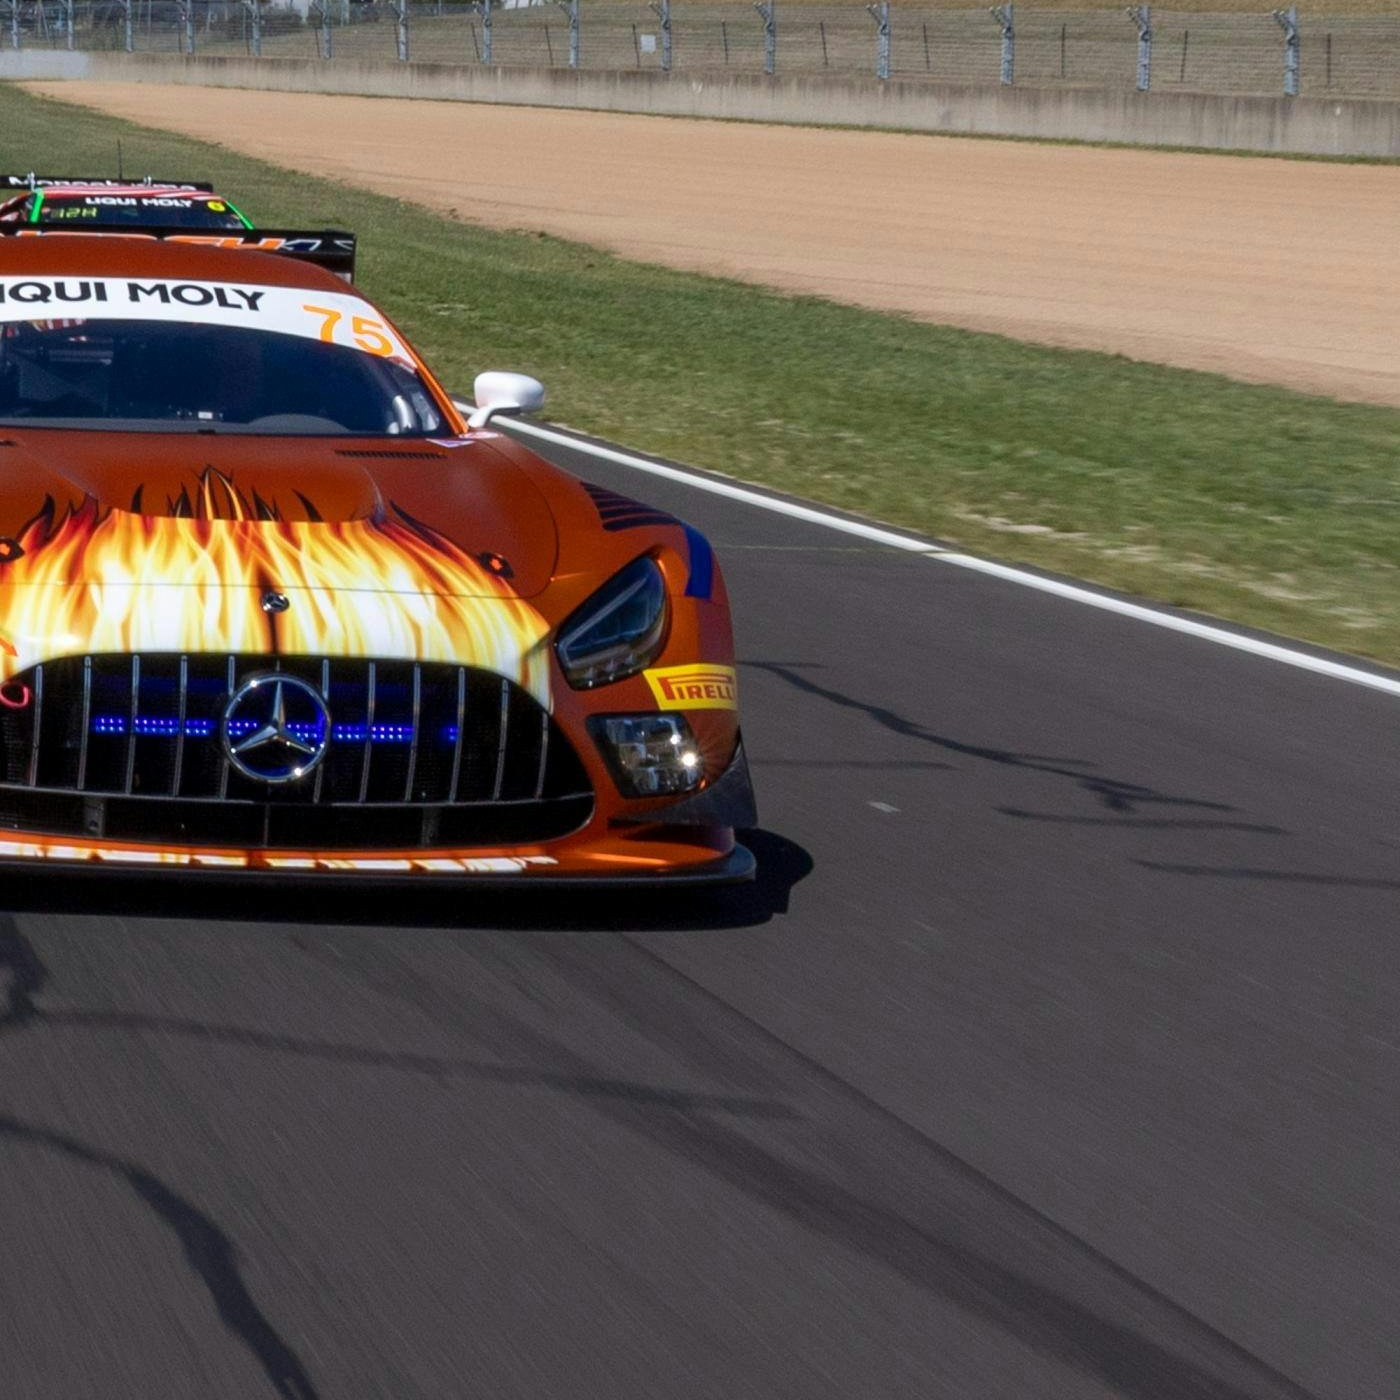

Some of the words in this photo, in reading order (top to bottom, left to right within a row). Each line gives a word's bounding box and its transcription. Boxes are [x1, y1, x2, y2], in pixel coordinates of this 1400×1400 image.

[85, 196, 137, 206] LIQUI
[142, 197, 193, 208] MOLY
[128, 282, 266, 311] MOLY
[302, 304, 394, 358] 75
